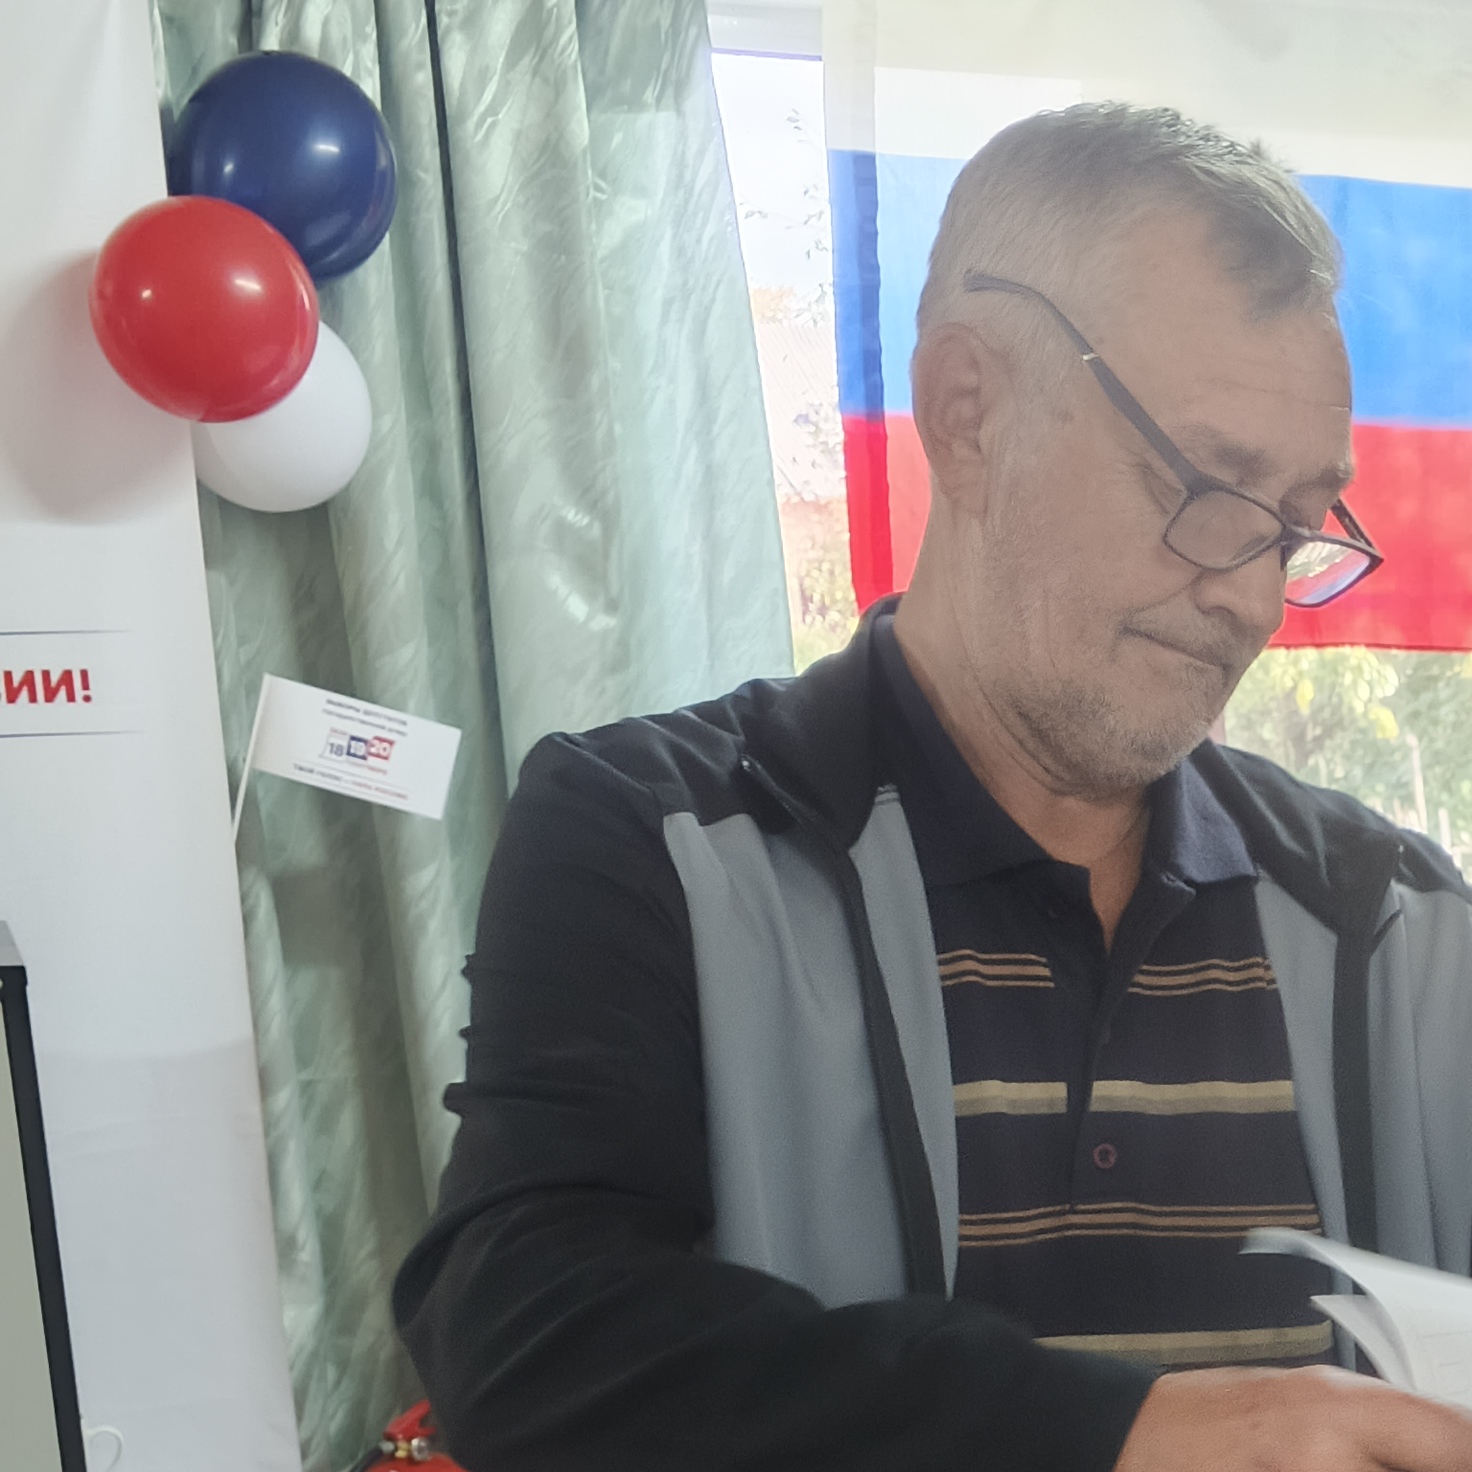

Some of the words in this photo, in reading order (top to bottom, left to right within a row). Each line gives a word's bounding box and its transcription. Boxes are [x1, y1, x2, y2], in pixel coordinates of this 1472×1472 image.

[0, 668, 92, 704] ИИ!
[328, 742, 345, 757] 18
[368, 738, 393, 756] 20
